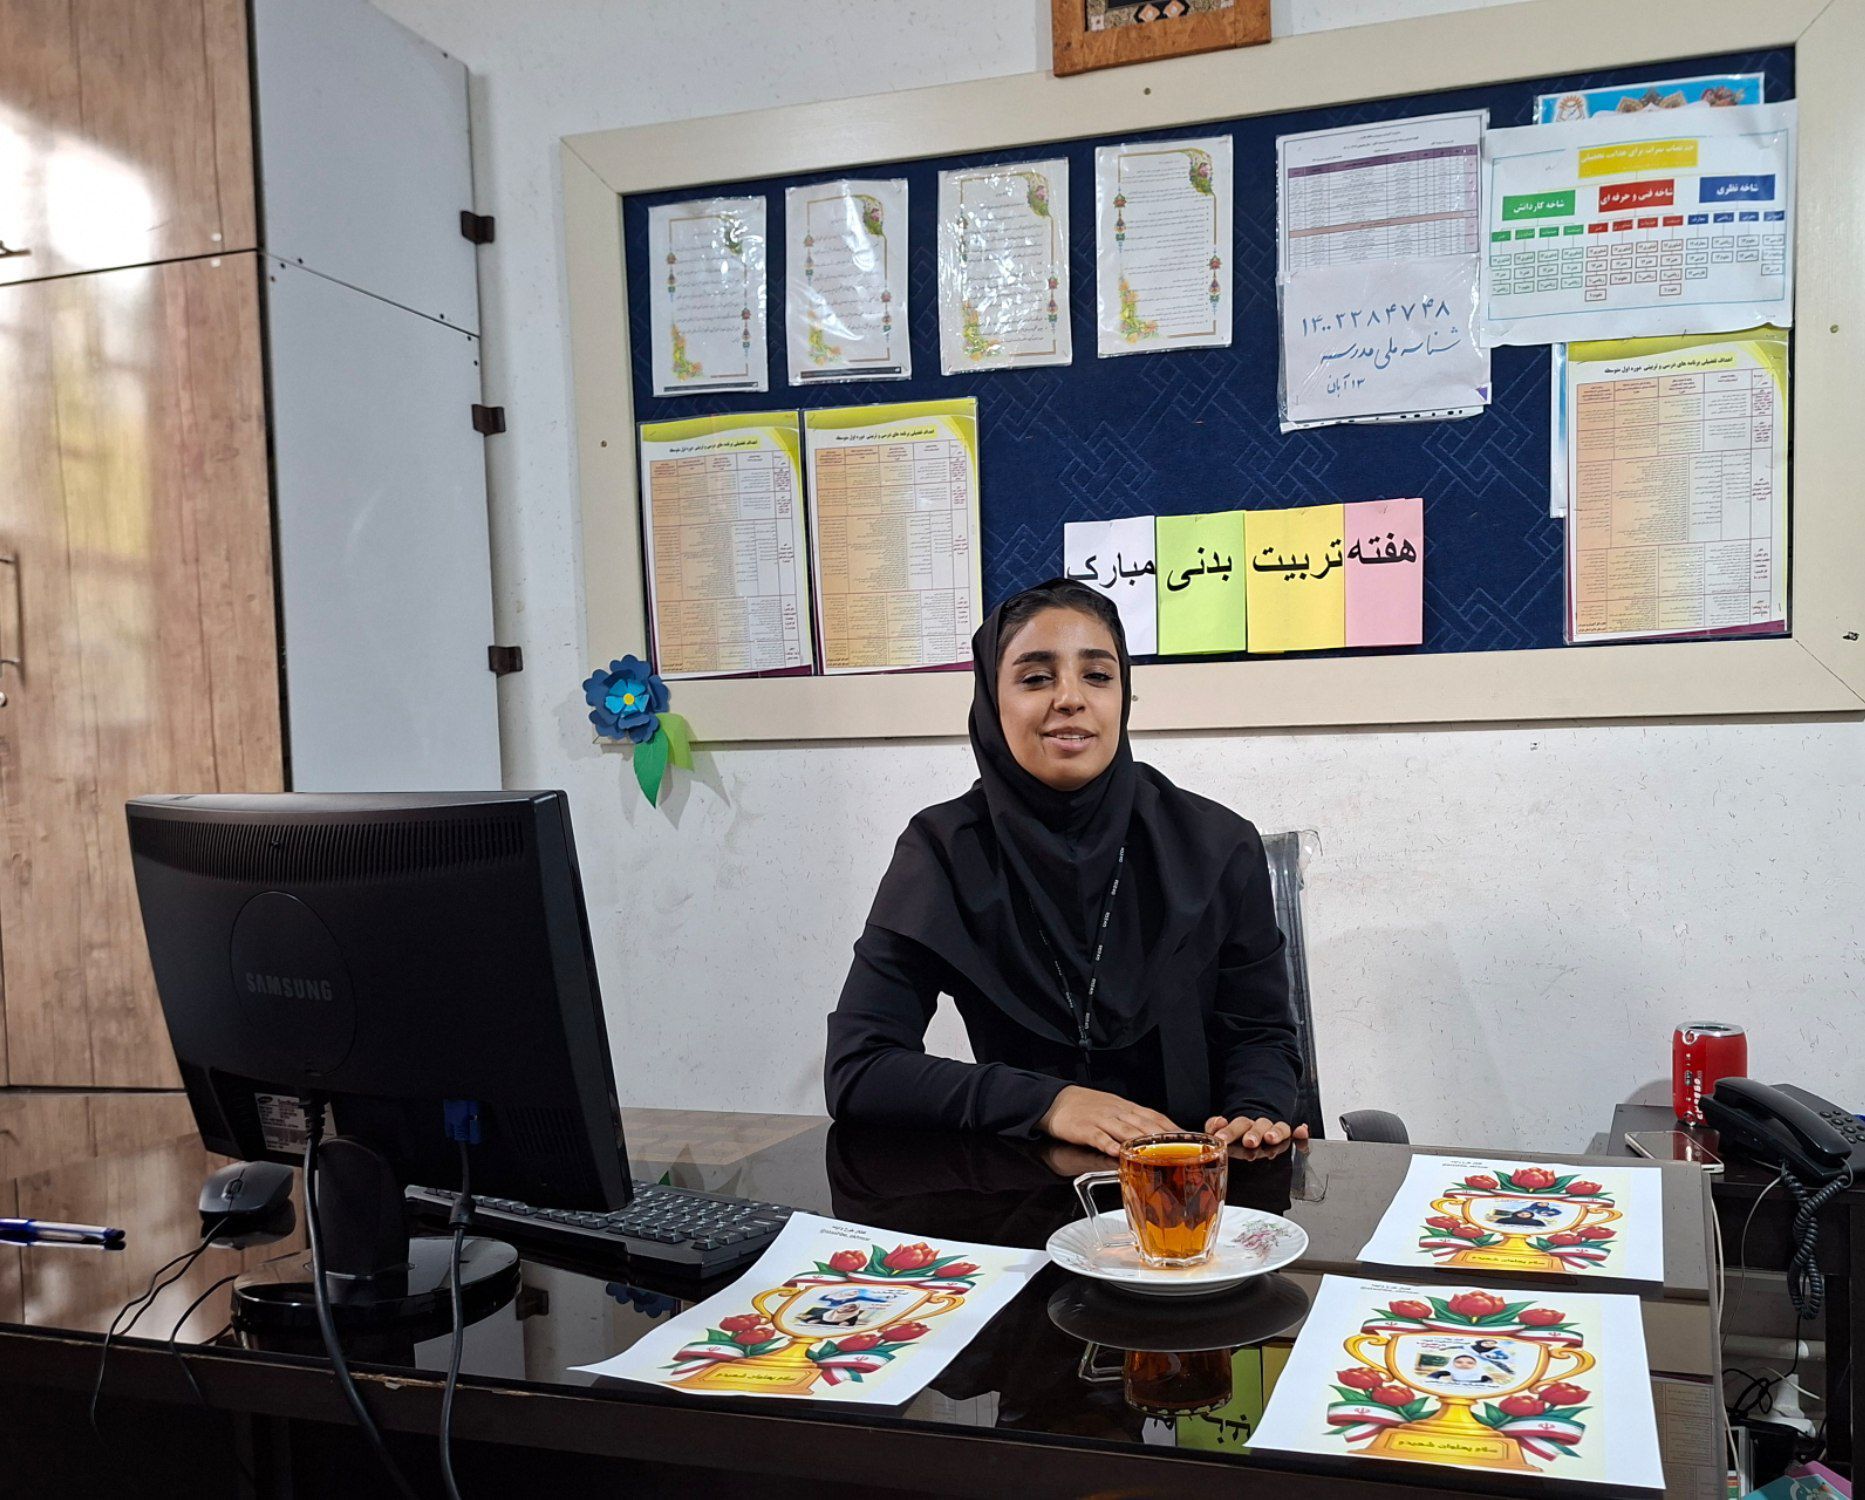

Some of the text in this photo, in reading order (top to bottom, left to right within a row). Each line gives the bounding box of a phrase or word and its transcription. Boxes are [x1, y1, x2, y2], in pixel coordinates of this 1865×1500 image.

[1640, 190, 1654, 202] فنی
[1655, 186, 1674, 198] شاخه
[1716, 182, 1759, 197] شاخه نظری
[1600, 194, 1612, 206] ای
[1613, 191, 1630, 204] حرفه
[1513, 199, 1565, 214] شاخه کاردانش
[1320, 326, 1461, 369] شناسه ملی مدرسه
[1327, 373, 1365, 398] ۱۳ آبان
[1066, 531, 1417, 592] هفته تربیت بدنی مبارک
[246, 972, 332, 1001] SAMSUNG
